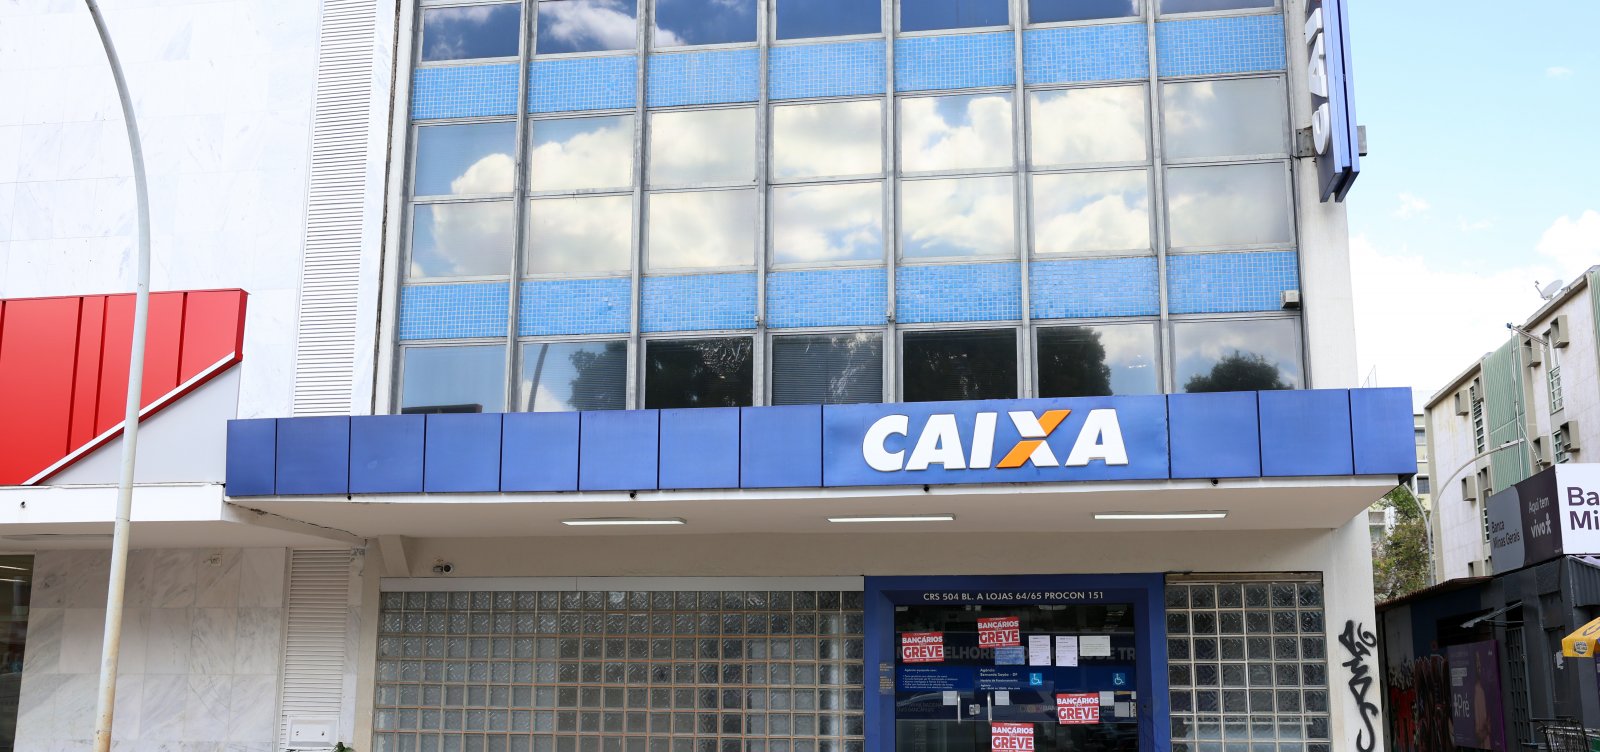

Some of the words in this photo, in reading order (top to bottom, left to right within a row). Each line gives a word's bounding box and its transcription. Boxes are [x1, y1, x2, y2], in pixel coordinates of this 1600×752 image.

[1305, 0, 1331, 155] CAI
[862, 408, 1129, 472] CAIXA
[1528, 498, 1539, 515] Aqui
[1539, 496, 1550, 509] tem
[1491, 520, 1505, 534] Banca
[1530, 519, 1546, 539] vivo
[1492, 535, 1506, 549] Minas
[1505, 529, 1520, 545] Gerais
[923, 592, 940, 601] CRS
[942, 592, 959, 601] 504
[961, 592, 974, 601] BL.
[976, 592, 984, 600] A
[986, 592, 1013, 600] LOJAS
[1015, 592, 1042, 600] 64/65
[1044, 591, 1085, 600] PROCON
[1088, 591, 1104, 599] 151
[977, 618, 1019, 629] BANCÁRIOS
[901, 635, 943, 644] BANCÁRIOS
[979, 630, 1019, 643] GREVE
[903, 645, 943, 658] GREVE
[1056, 696, 1099, 705] BANCÁRIOS
[1058, 707, 1099, 720] GREVE
[991, 726, 1034, 735] BANCÁRIOS
[992, 737, 1033, 750] GREVE
